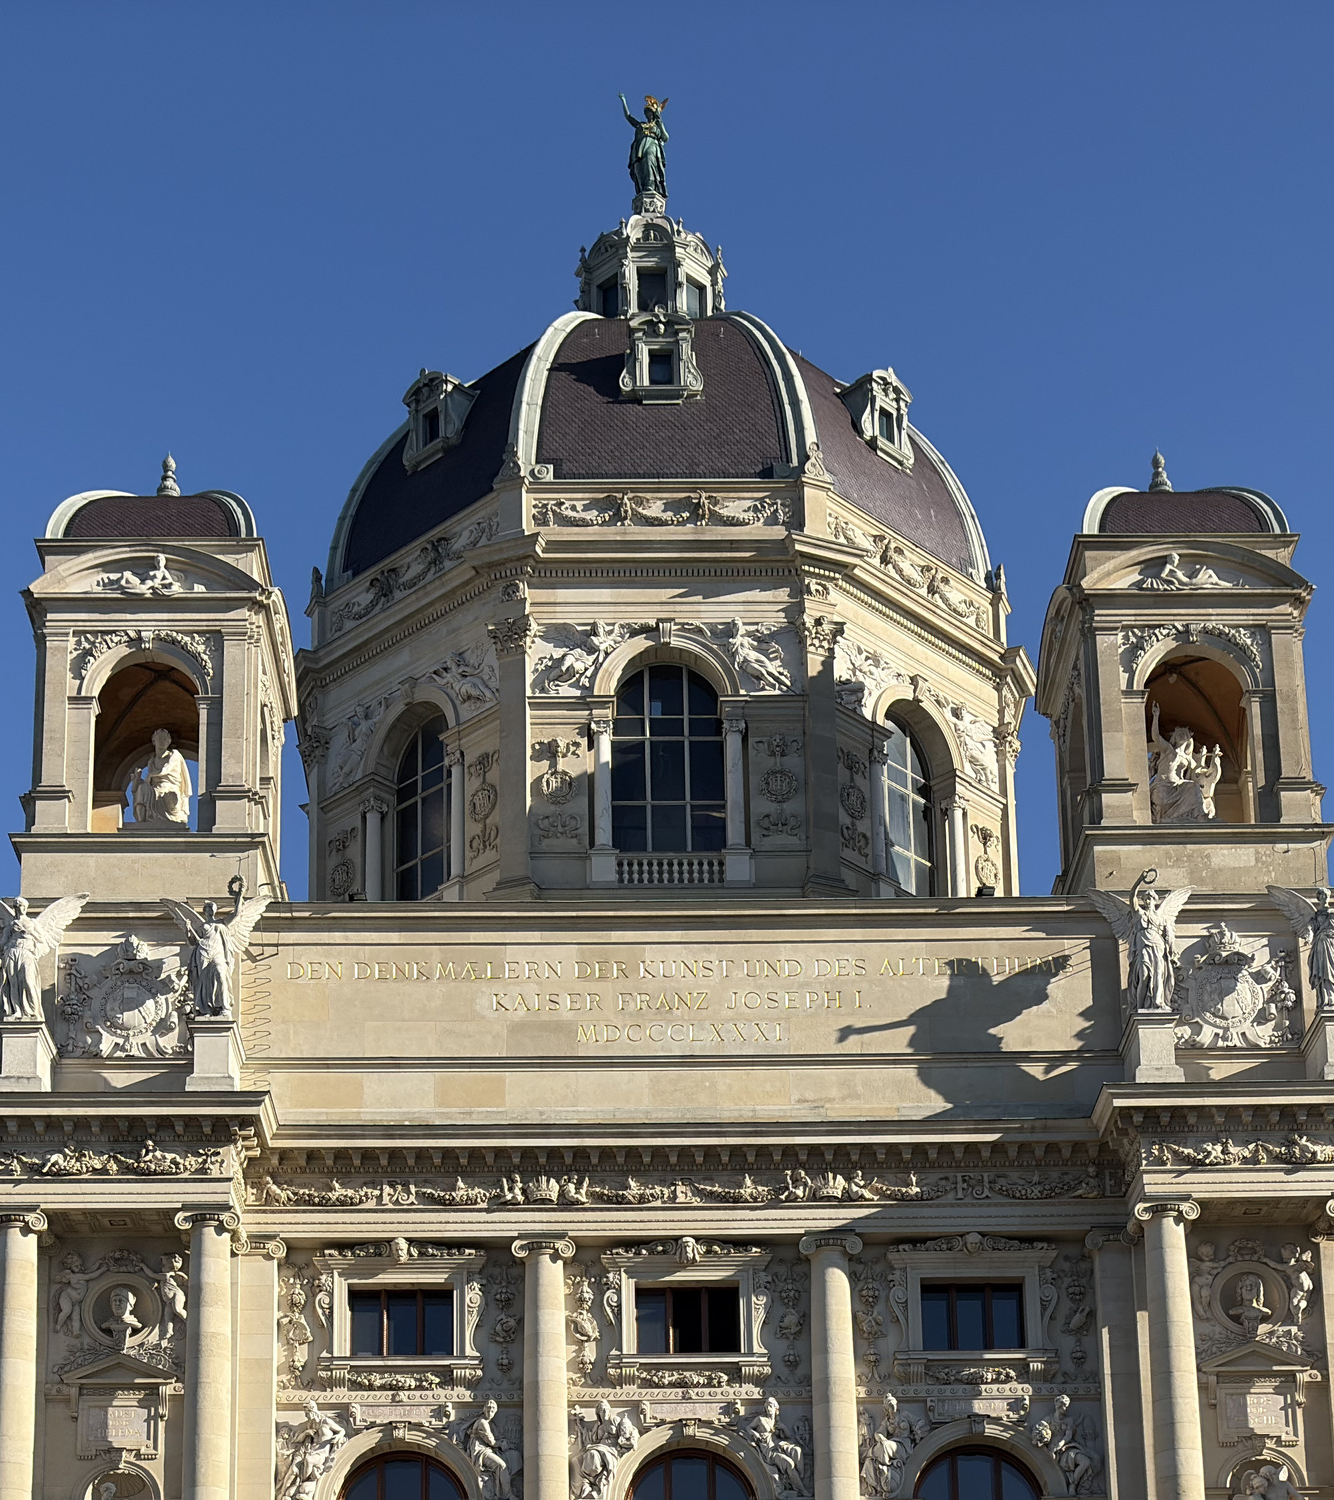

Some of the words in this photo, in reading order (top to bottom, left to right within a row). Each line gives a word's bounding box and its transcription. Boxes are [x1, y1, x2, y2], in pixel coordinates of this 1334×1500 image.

[286, 961, 343, 980] DEN
[573, 960, 627, 980] DER
[638, 959, 735, 979] KUNST
[742, 958, 803, 978] UND
[813, 957, 867, 977] DES
[878, 954, 1075, 976] ALTERTHUMS
[491, 993, 605, 1012] KAISER
[616, 991, 709, 1011] FRANZ
[726, 990, 842, 1010] JOSEPH
[575, 1022, 790, 1043] MDCCCLXXXI.
